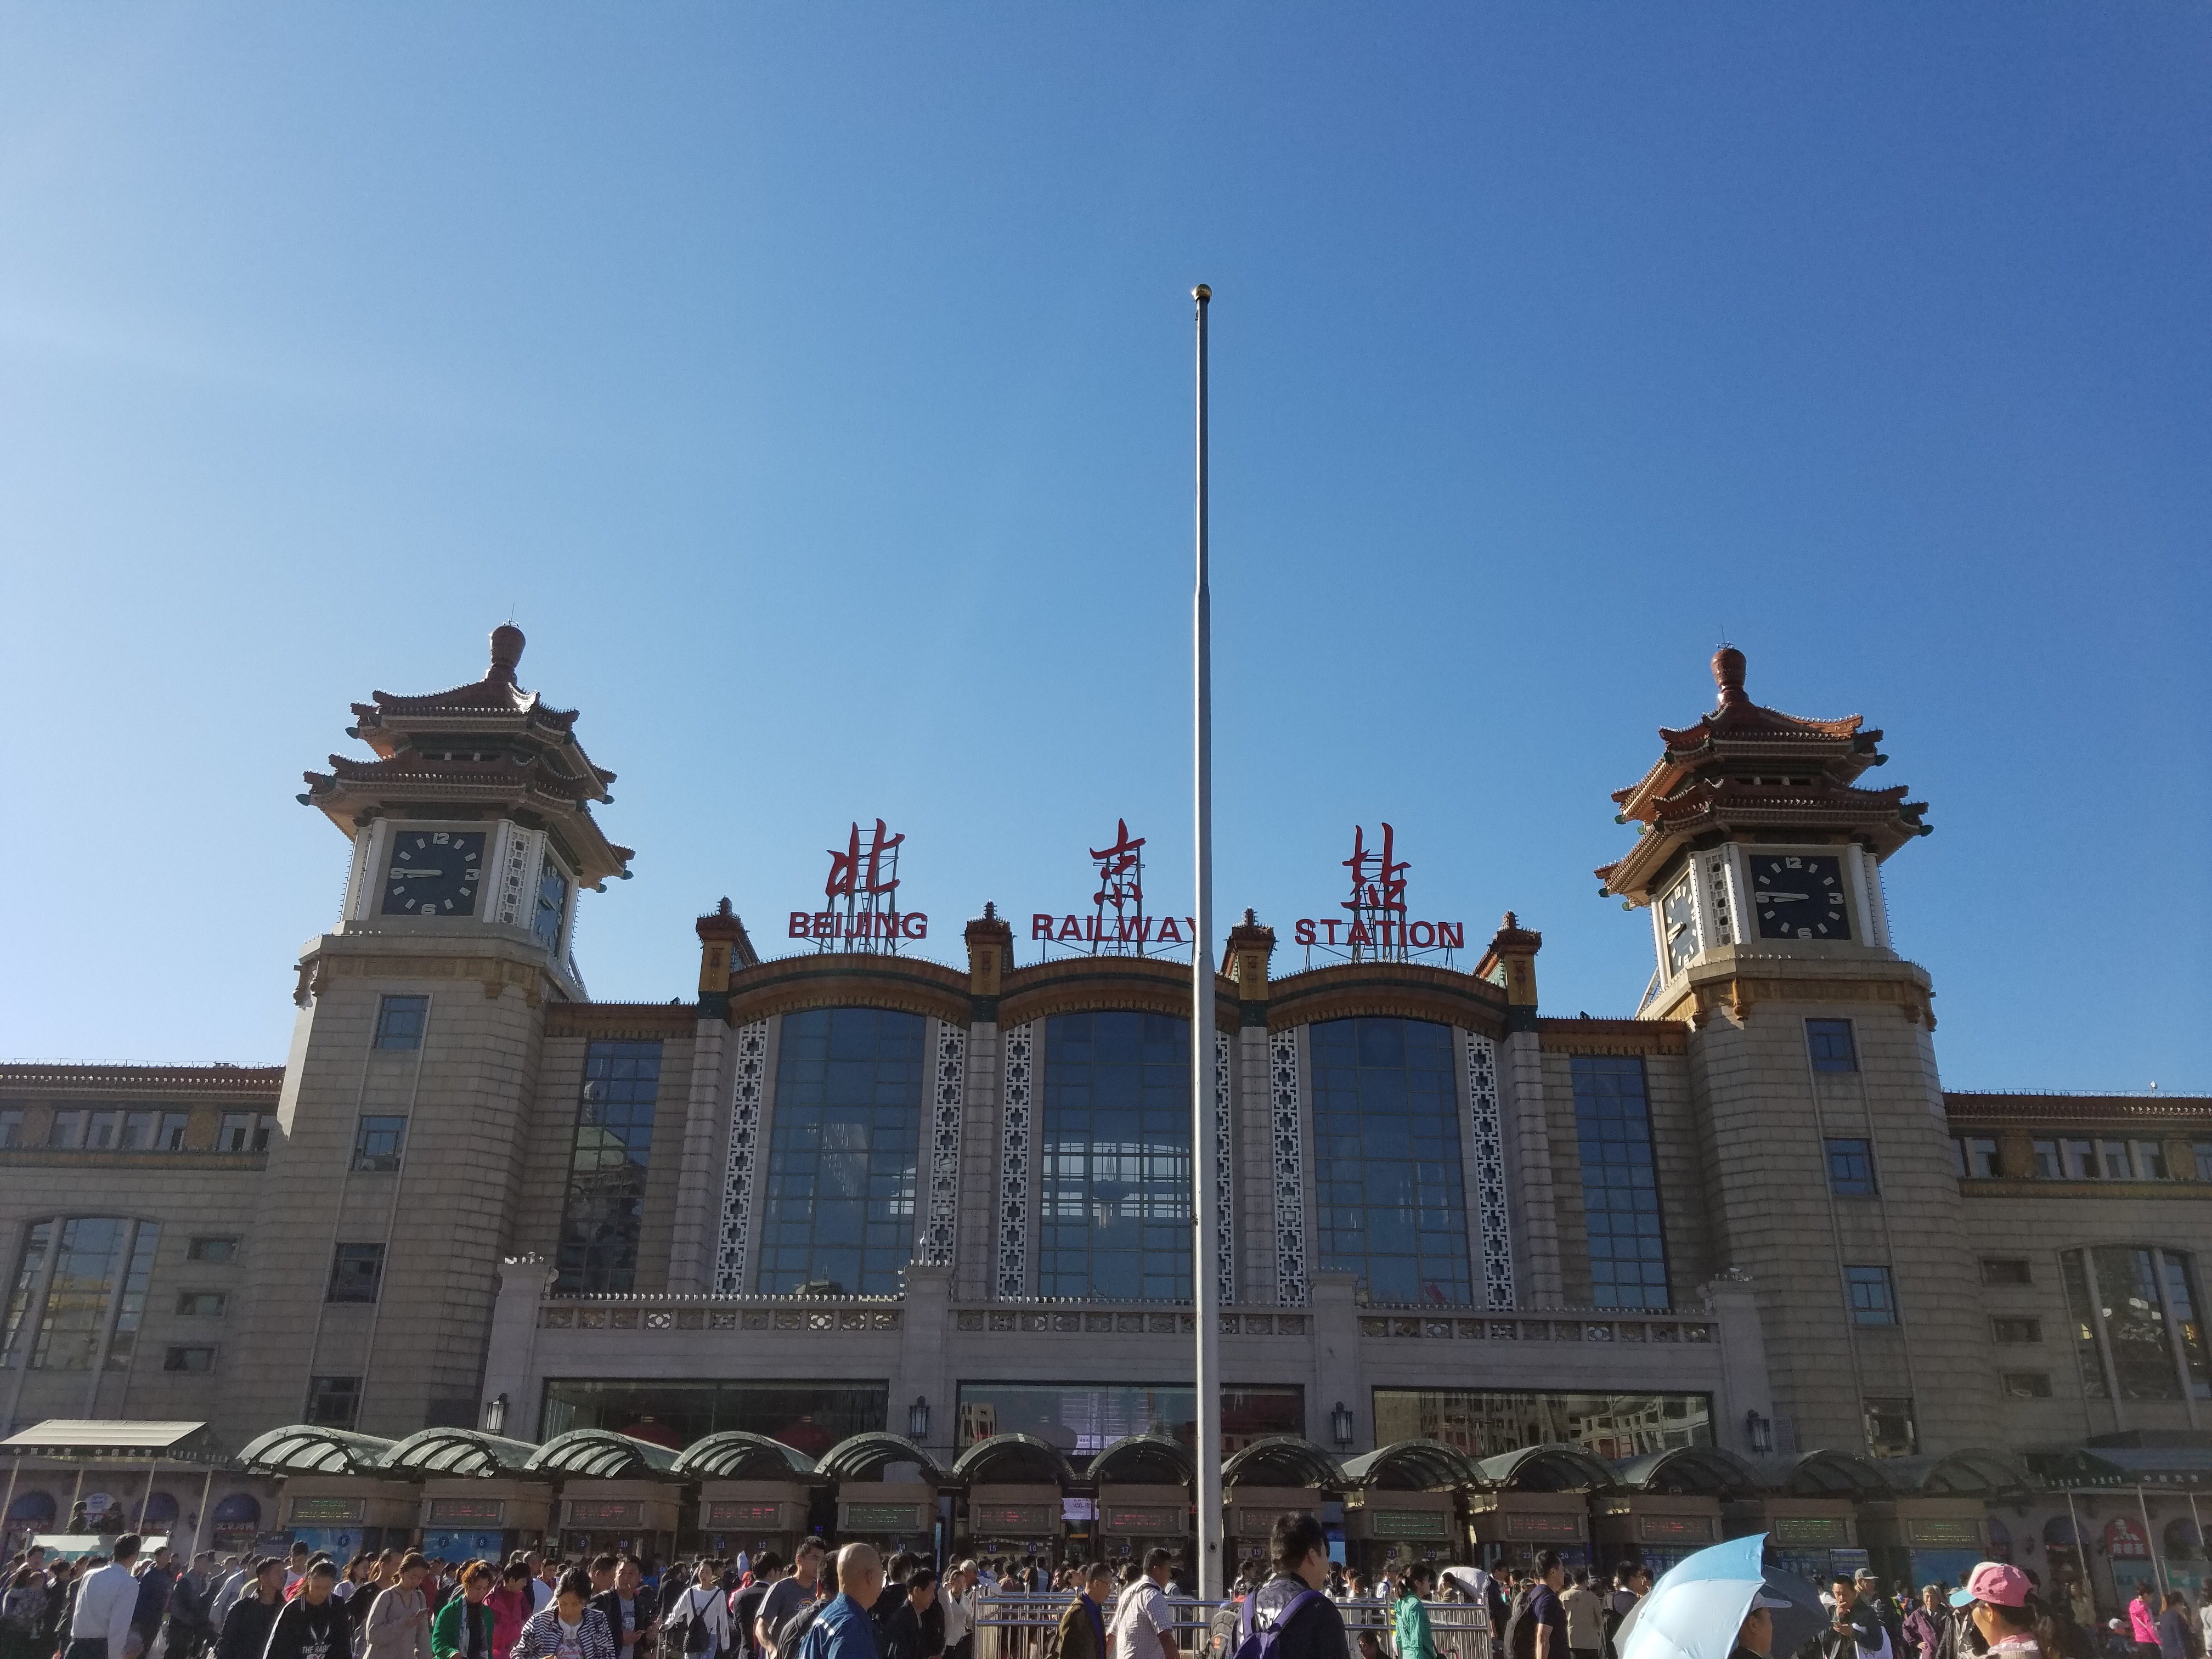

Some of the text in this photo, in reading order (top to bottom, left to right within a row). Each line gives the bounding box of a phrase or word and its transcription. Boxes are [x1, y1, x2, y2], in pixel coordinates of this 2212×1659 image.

[432, 833, 449, 844] 12
[1786, 857, 1802, 868] 12
[465, 868, 480, 880] 3
[1829, 893, 1844, 904] 3
[421, 904, 436, 915] 6
[788, 912, 928, 939] BEIJING
[1295, 918, 1464, 949] STATION
[302, 1646, 314, 1654] THE
